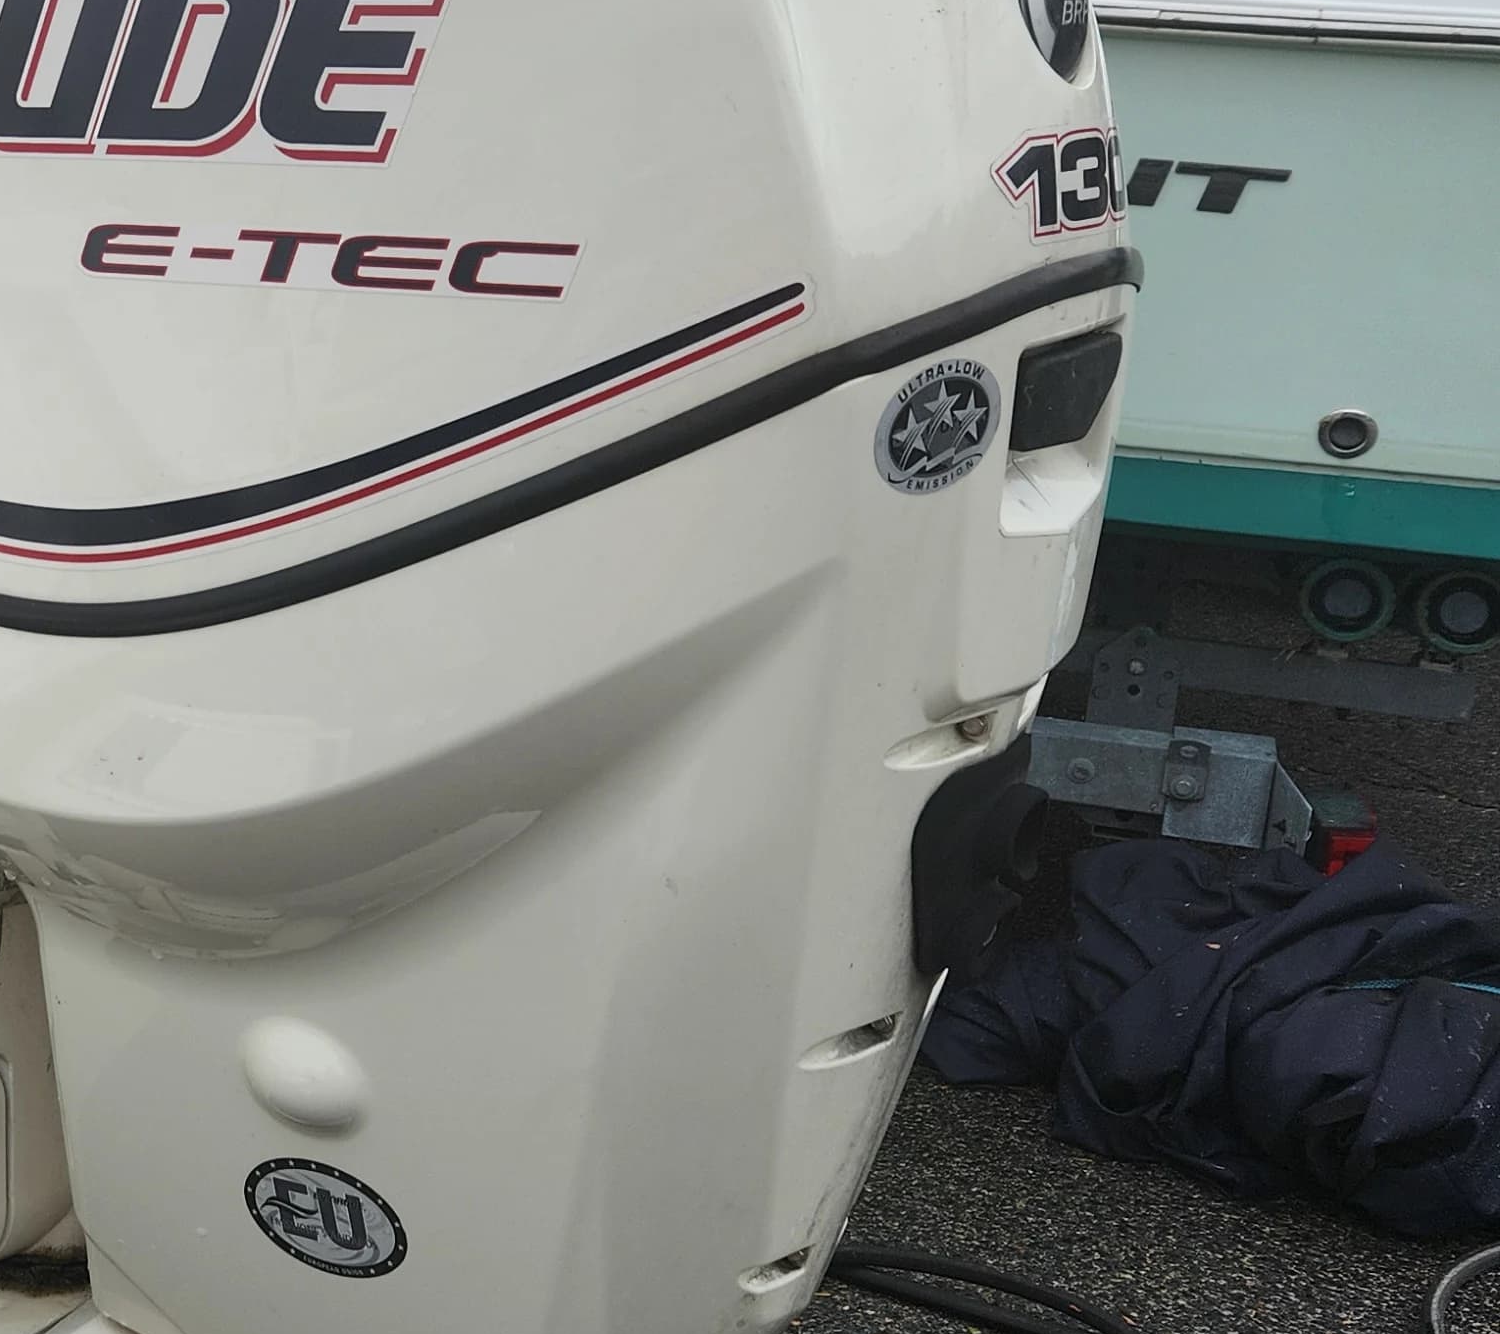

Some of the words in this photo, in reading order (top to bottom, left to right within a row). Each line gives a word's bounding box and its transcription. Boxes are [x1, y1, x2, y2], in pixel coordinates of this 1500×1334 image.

[80, 223, 580, 298] E-TEC
[906, 458, 974, 490] EMISSION
[273, 1177, 367, 1250] EU
